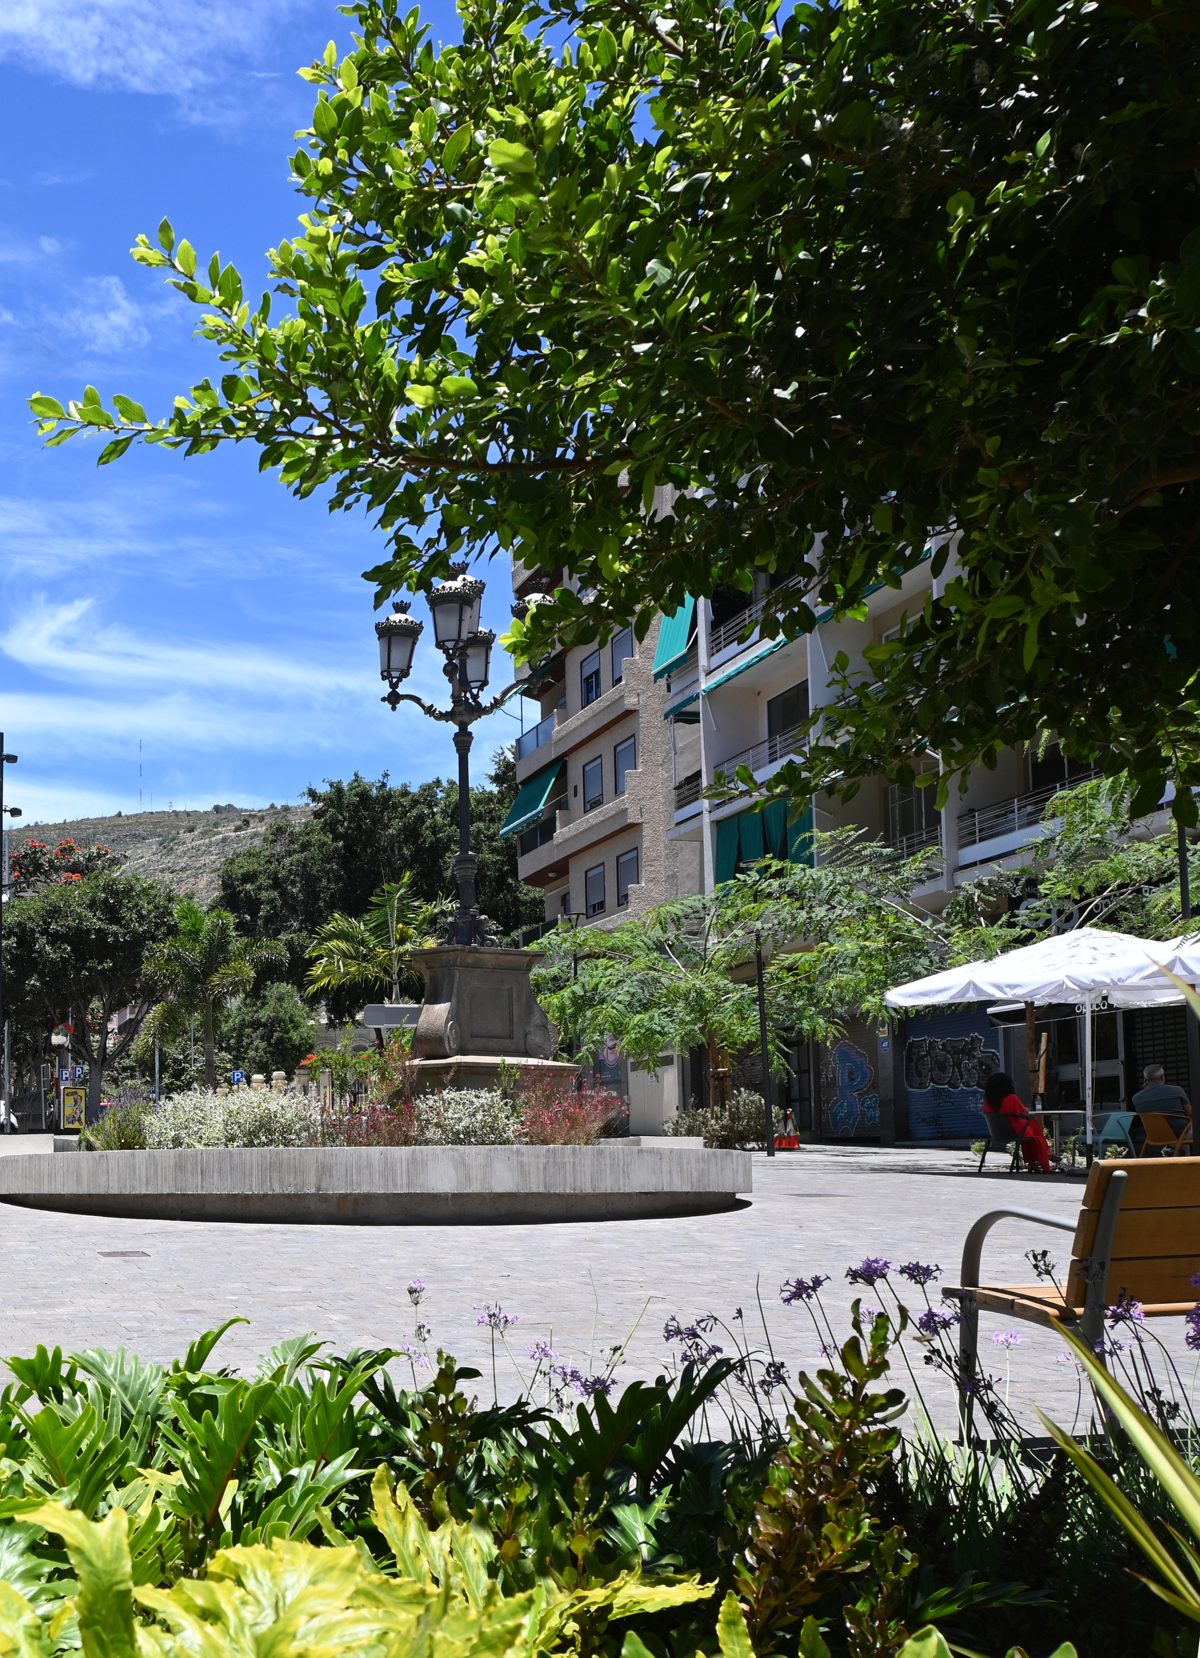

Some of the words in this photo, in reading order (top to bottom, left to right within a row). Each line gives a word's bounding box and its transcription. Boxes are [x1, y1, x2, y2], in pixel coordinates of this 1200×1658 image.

[62, 1070, 70, 1081] P
[75, 1067, 83, 1078] P
[234, 1072, 242, 1082] P
